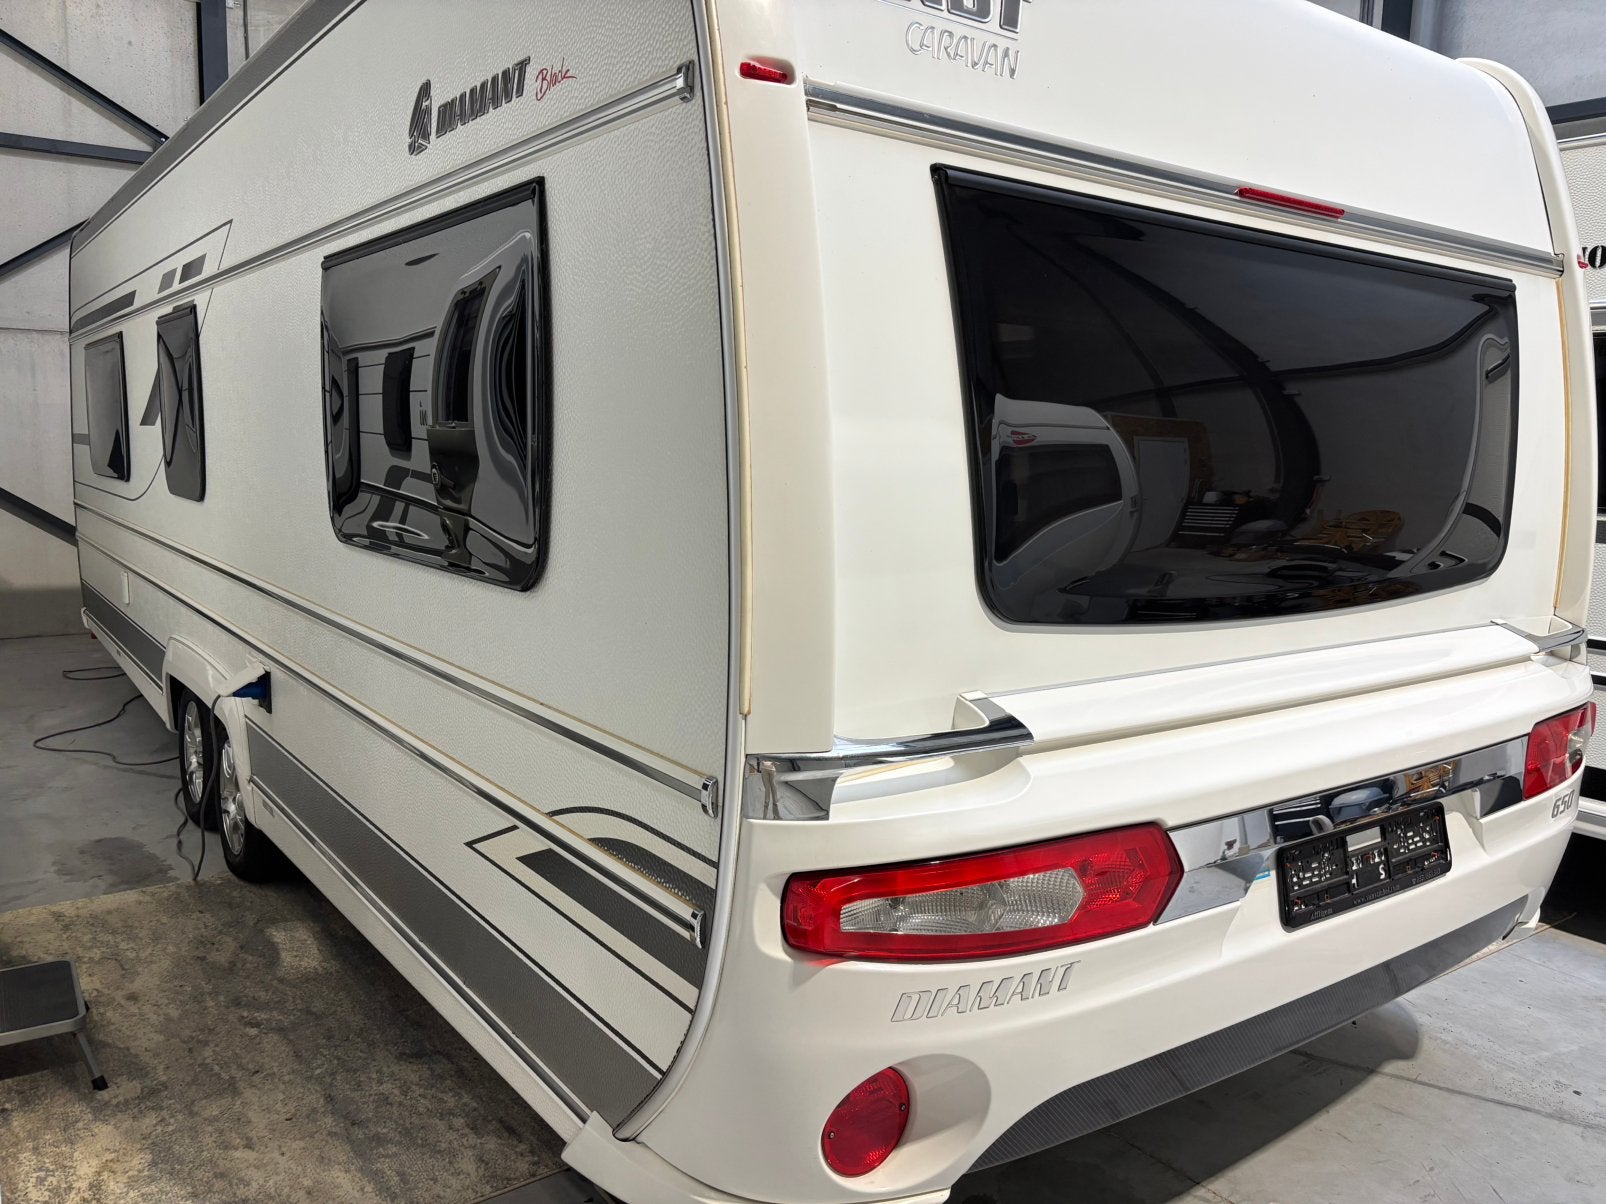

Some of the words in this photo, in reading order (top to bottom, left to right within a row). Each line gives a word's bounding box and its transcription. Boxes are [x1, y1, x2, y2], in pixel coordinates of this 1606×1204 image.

[905, 21, 1020, 80] CARAVAN
[435, 56, 531, 139] DIAMANT
[535, 57, 578, 101] Black
[1551, 789, 1575, 819] 650
[890, 959, 1082, 1023] DIAMANT
